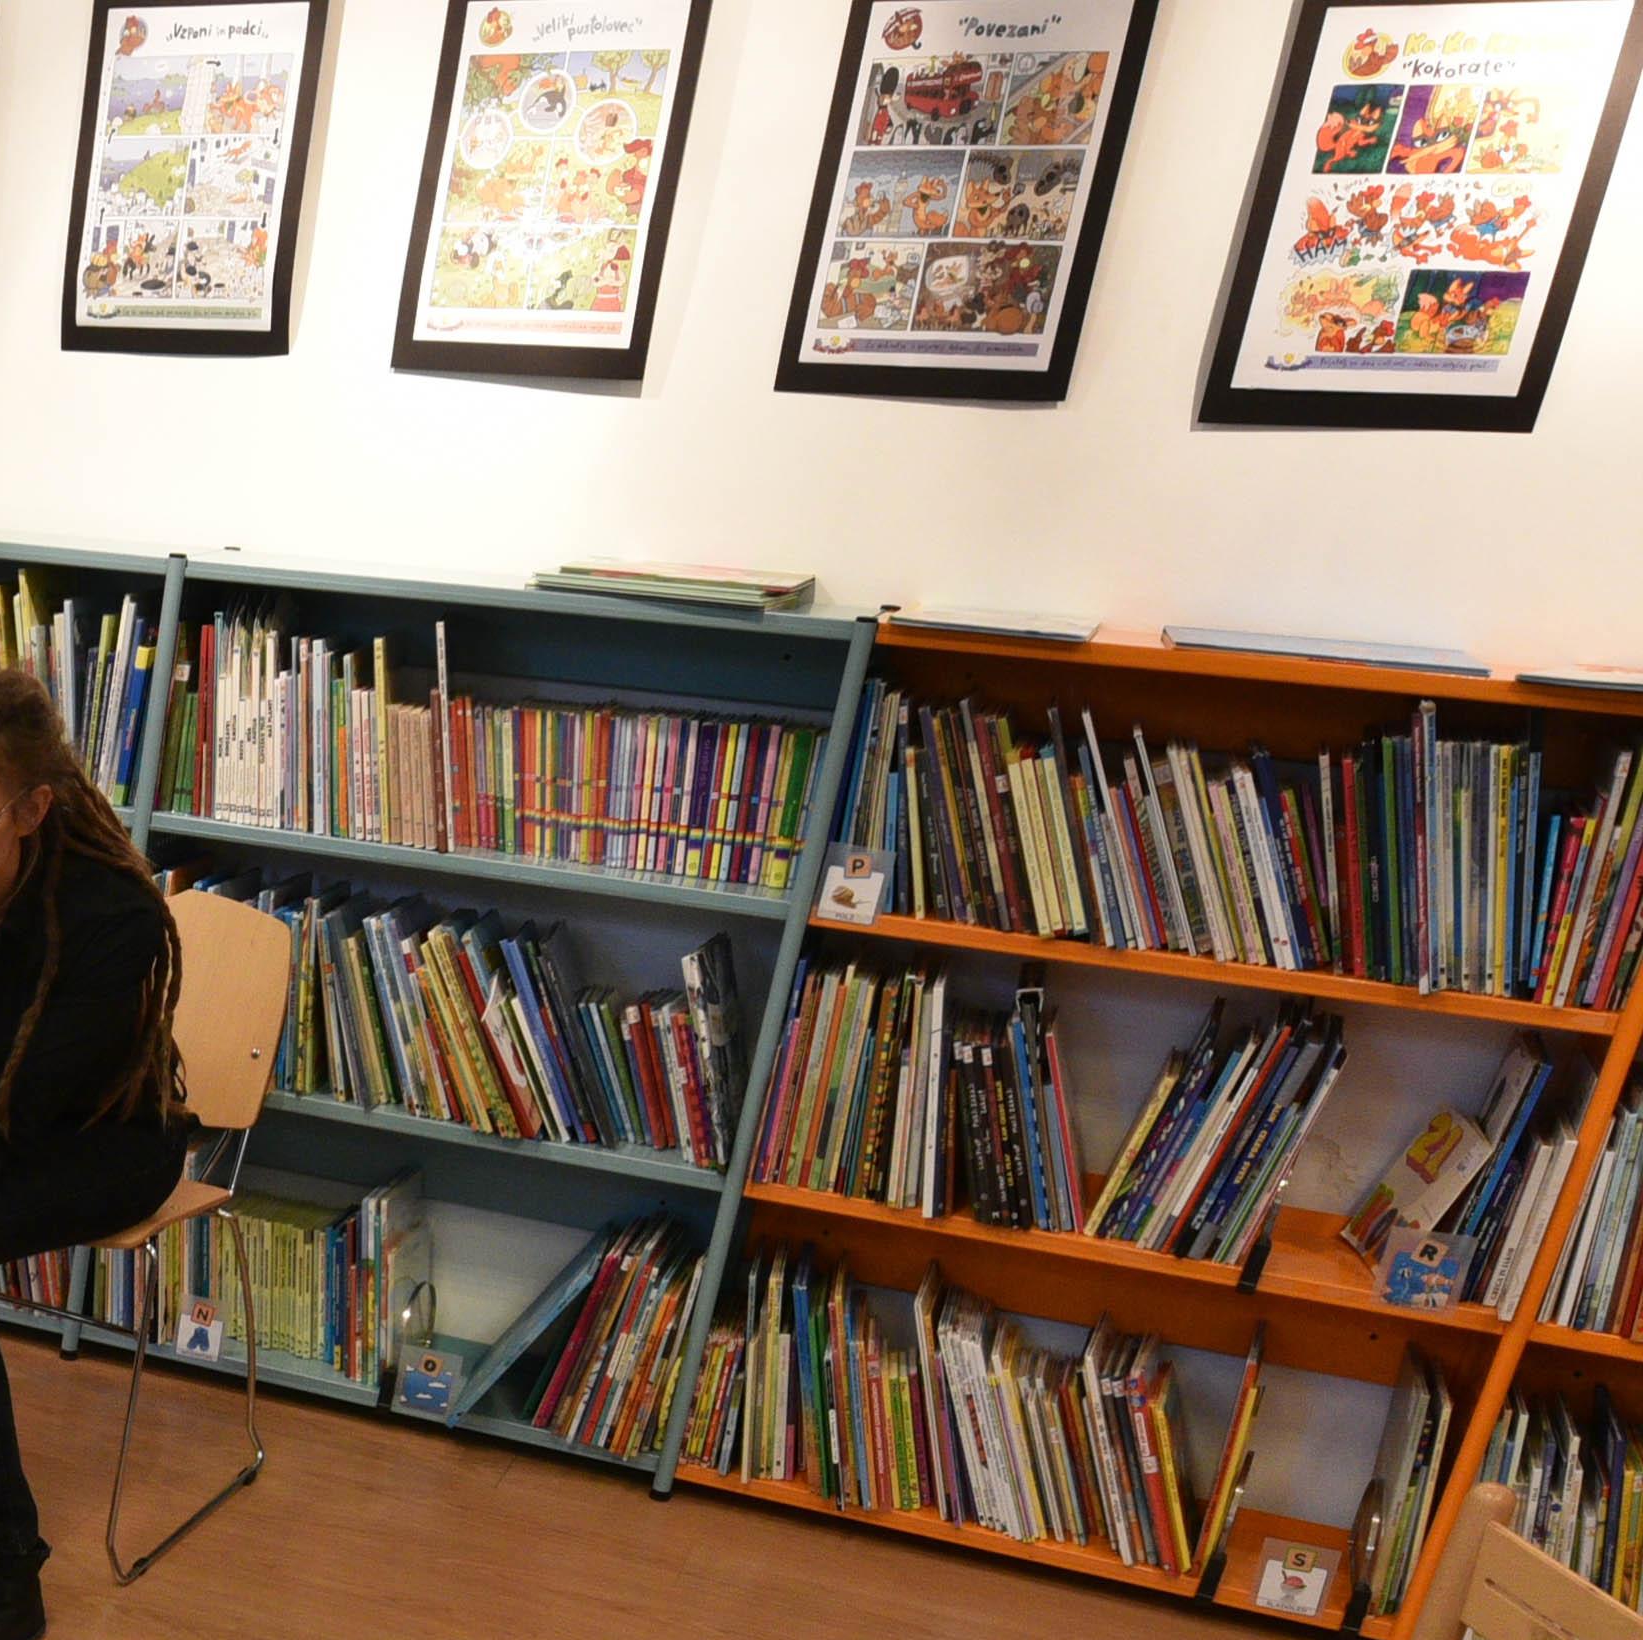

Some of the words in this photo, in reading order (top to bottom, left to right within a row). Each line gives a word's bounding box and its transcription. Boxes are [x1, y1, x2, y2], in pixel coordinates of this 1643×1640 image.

[852, 859, 865, 874] P
[1420, 1245, 1439, 1261] R
[197, 1308, 211, 1320] N
[423, 1358, 438, 1373] O
[1292, 1553, 1306, 1567] S
